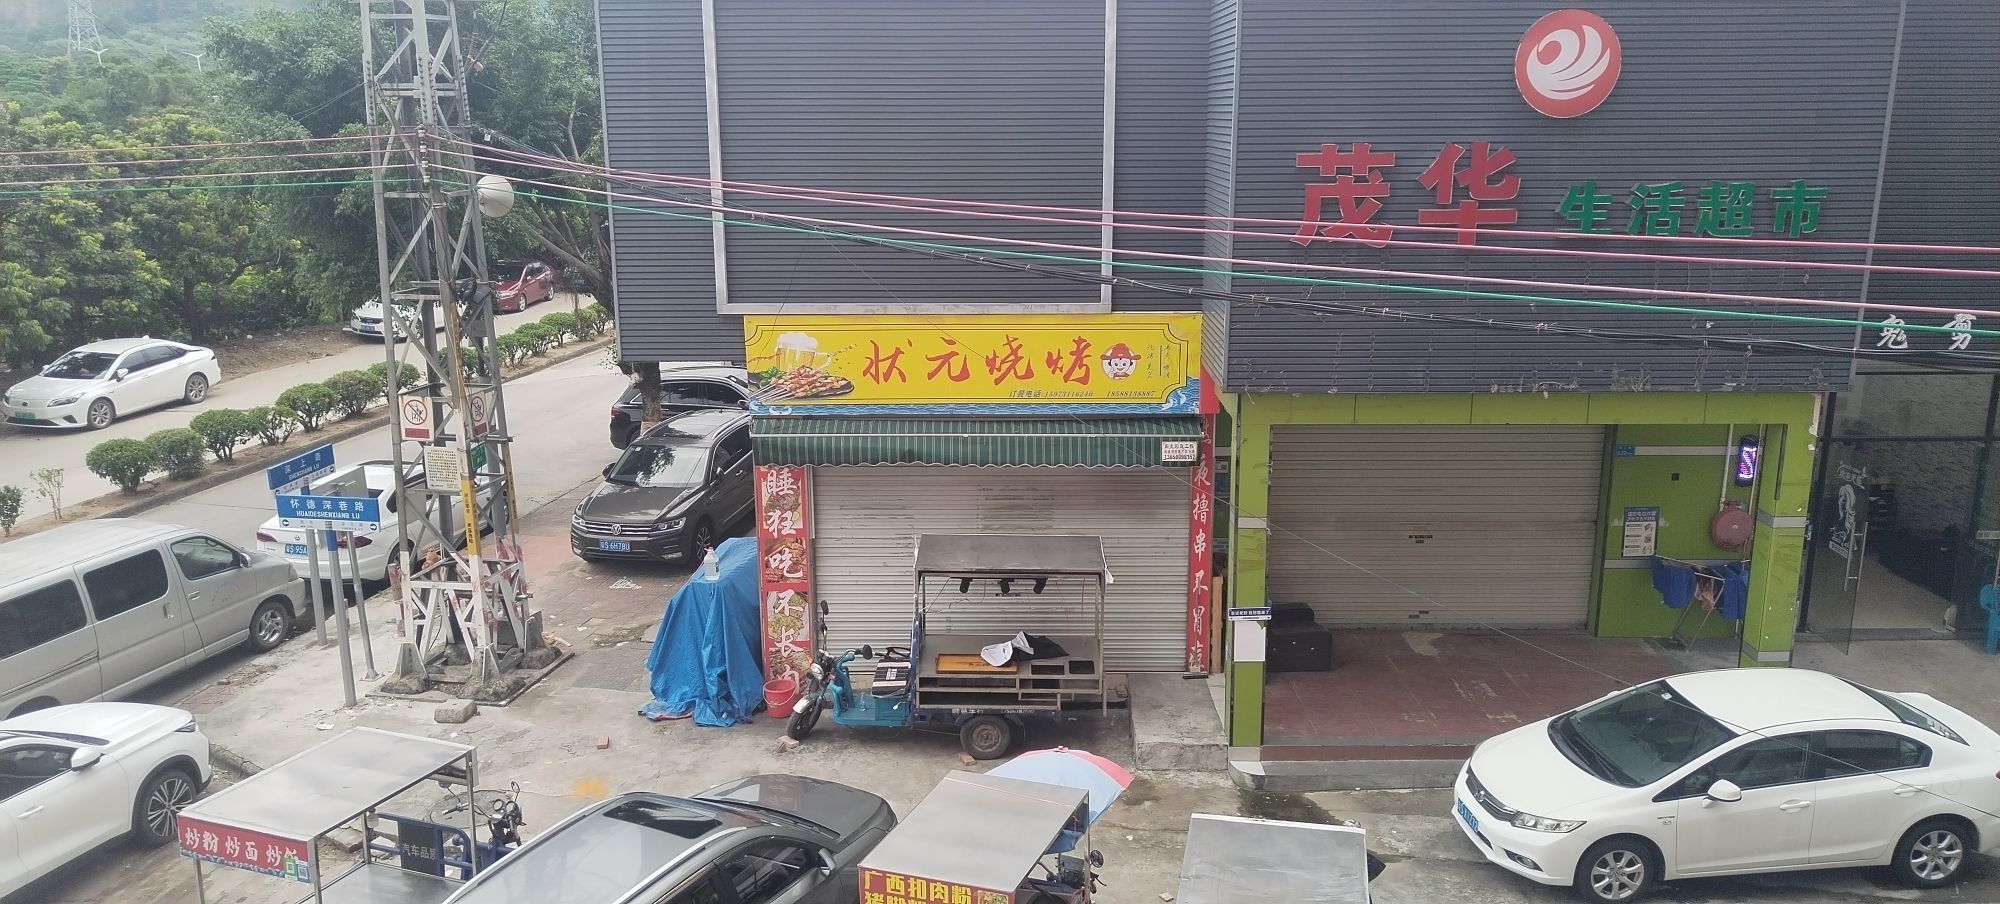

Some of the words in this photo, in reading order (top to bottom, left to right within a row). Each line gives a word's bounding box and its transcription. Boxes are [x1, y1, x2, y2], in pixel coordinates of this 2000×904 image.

[1289, 141, 1521, 248] 茂华
[1555, 179, 1829, 239] 生活超市
[862, 333, 1093, 386] 状元烧烤
[290, 498, 364, 512] 怀德深巷路
[296, 511, 349, 519] HUAIDESHENXIANG
[184, 827, 219, 853] 炒粉
[225, 835, 258, 861] 炒面
[864, 870, 972, 904] 广西扣肉粉
